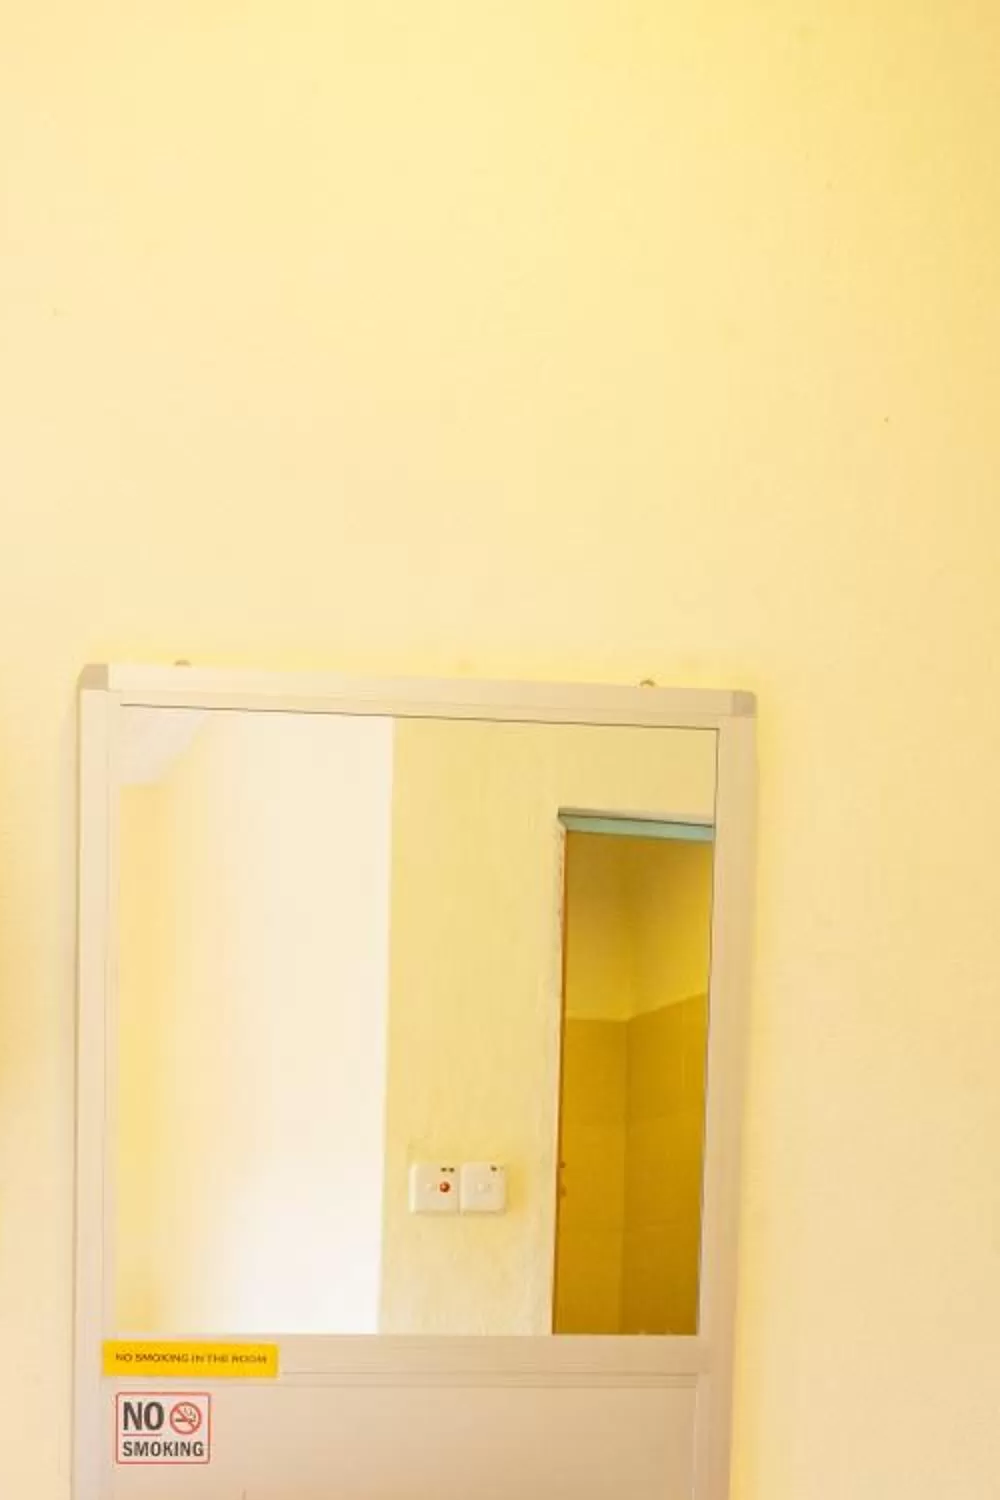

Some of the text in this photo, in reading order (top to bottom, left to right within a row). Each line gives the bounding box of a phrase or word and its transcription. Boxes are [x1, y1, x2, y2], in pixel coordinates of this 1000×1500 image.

[115, 1352, 268, 1365] NO SMOKING IN THE ROOM
[123, 1402, 164, 1430] NO
[122, 1441, 204, 1457] SMOKING
